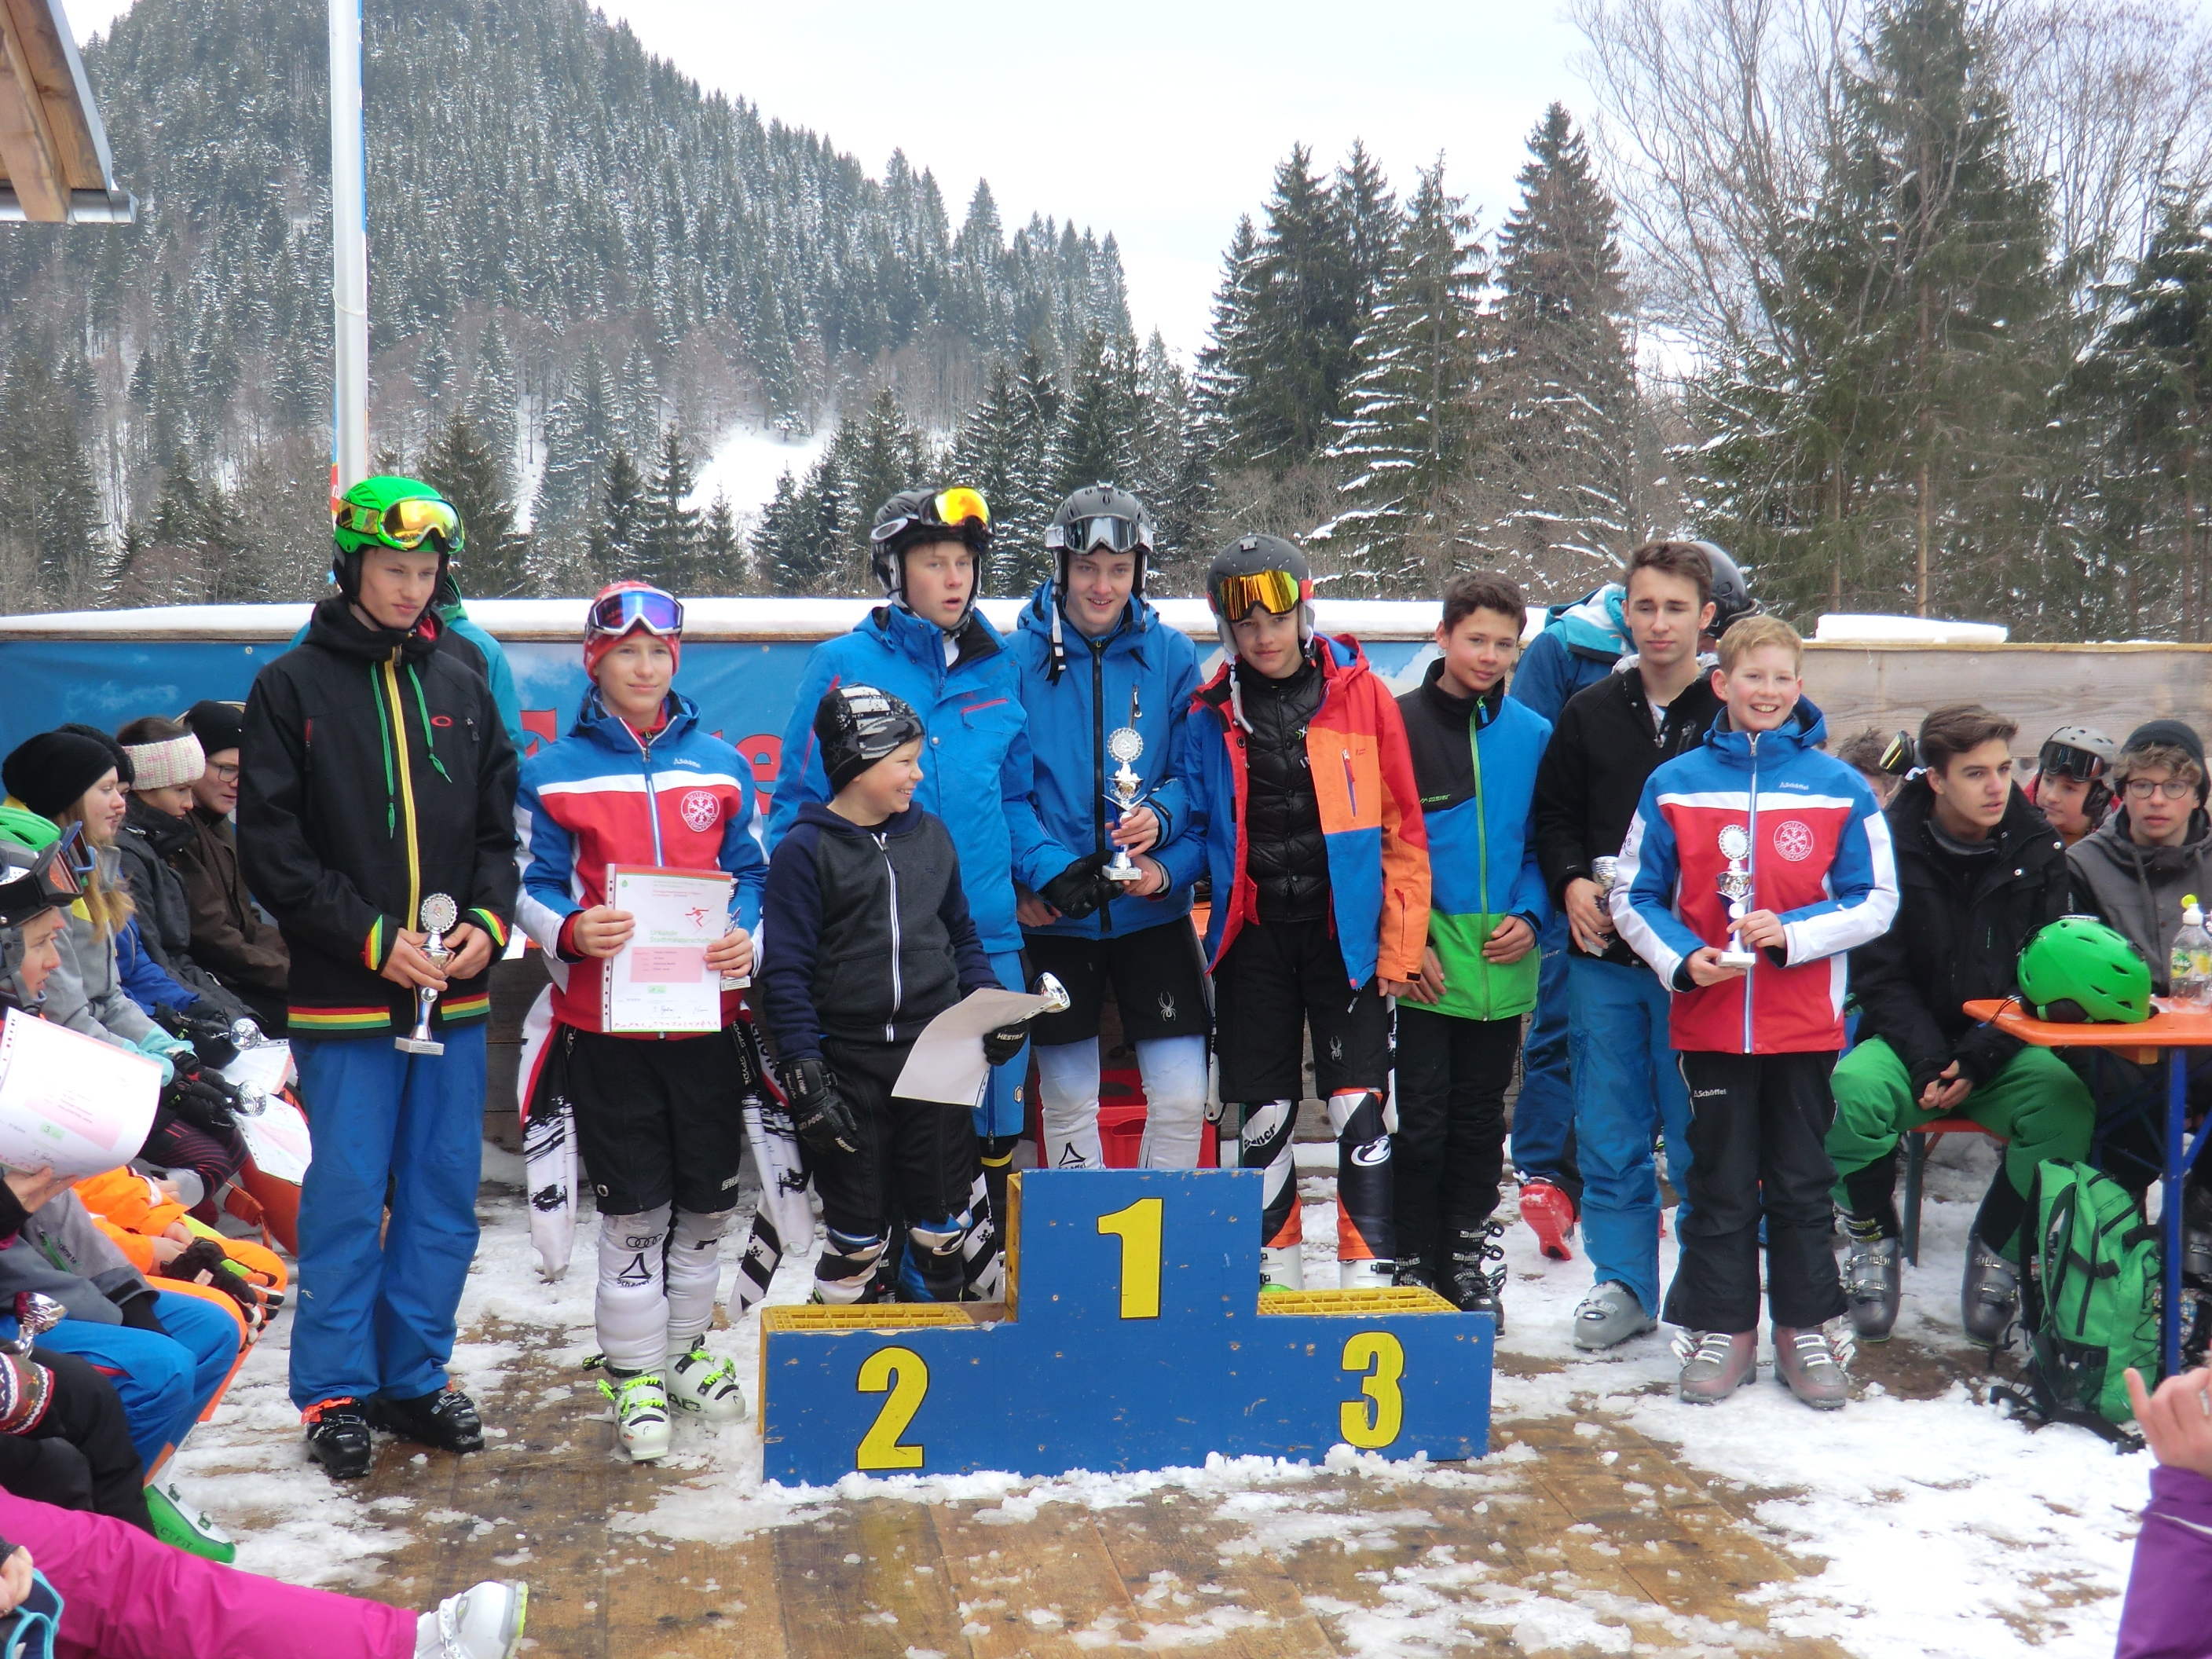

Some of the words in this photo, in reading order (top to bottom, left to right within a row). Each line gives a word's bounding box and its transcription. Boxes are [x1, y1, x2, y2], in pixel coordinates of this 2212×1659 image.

[996, 1031, 1025, 1042] HESTRA
[1698, 1088, 1727, 1097] Schöffel
[834, 1137, 858, 1153] HESTRA
[1097, 1197, 1163, 1320] 1
[855, 1345, 930, 1470] 2
[1339, 1331, 1404, 1449] 3
